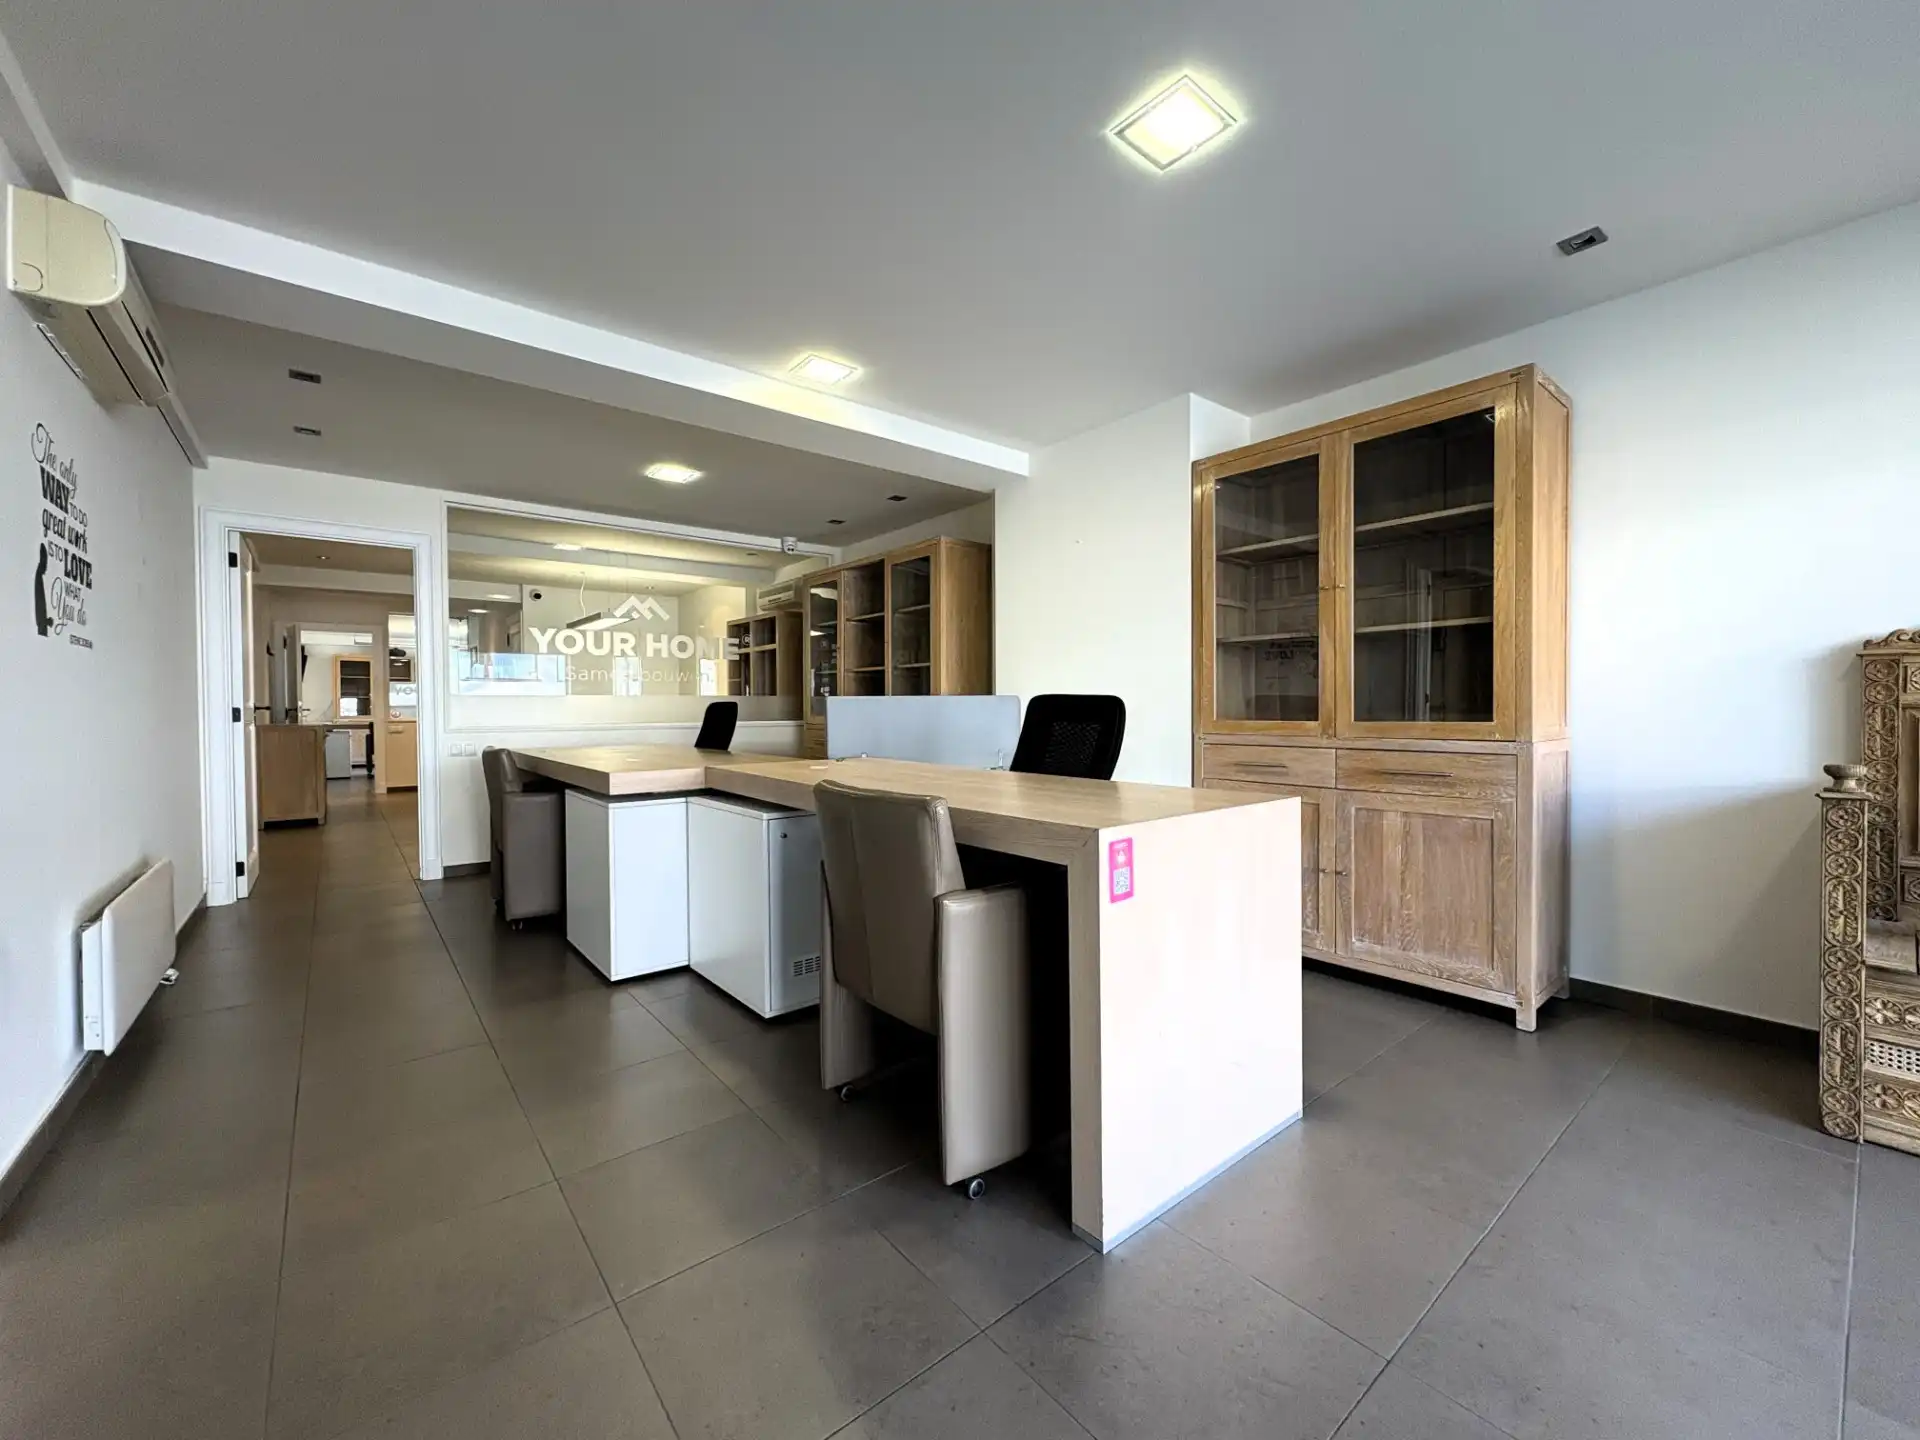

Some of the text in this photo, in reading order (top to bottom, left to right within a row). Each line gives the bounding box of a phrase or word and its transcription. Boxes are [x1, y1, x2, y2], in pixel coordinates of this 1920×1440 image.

[31, 422, 77, 500] The only
[40, 465, 88, 527] WAY TO DO
[42, 508, 87, 554] great work
[47, 539, 92, 590] IS TO LOVE
[64, 581, 82, 602] WHAT
[528, 627, 740, 661] YOUR HOME
